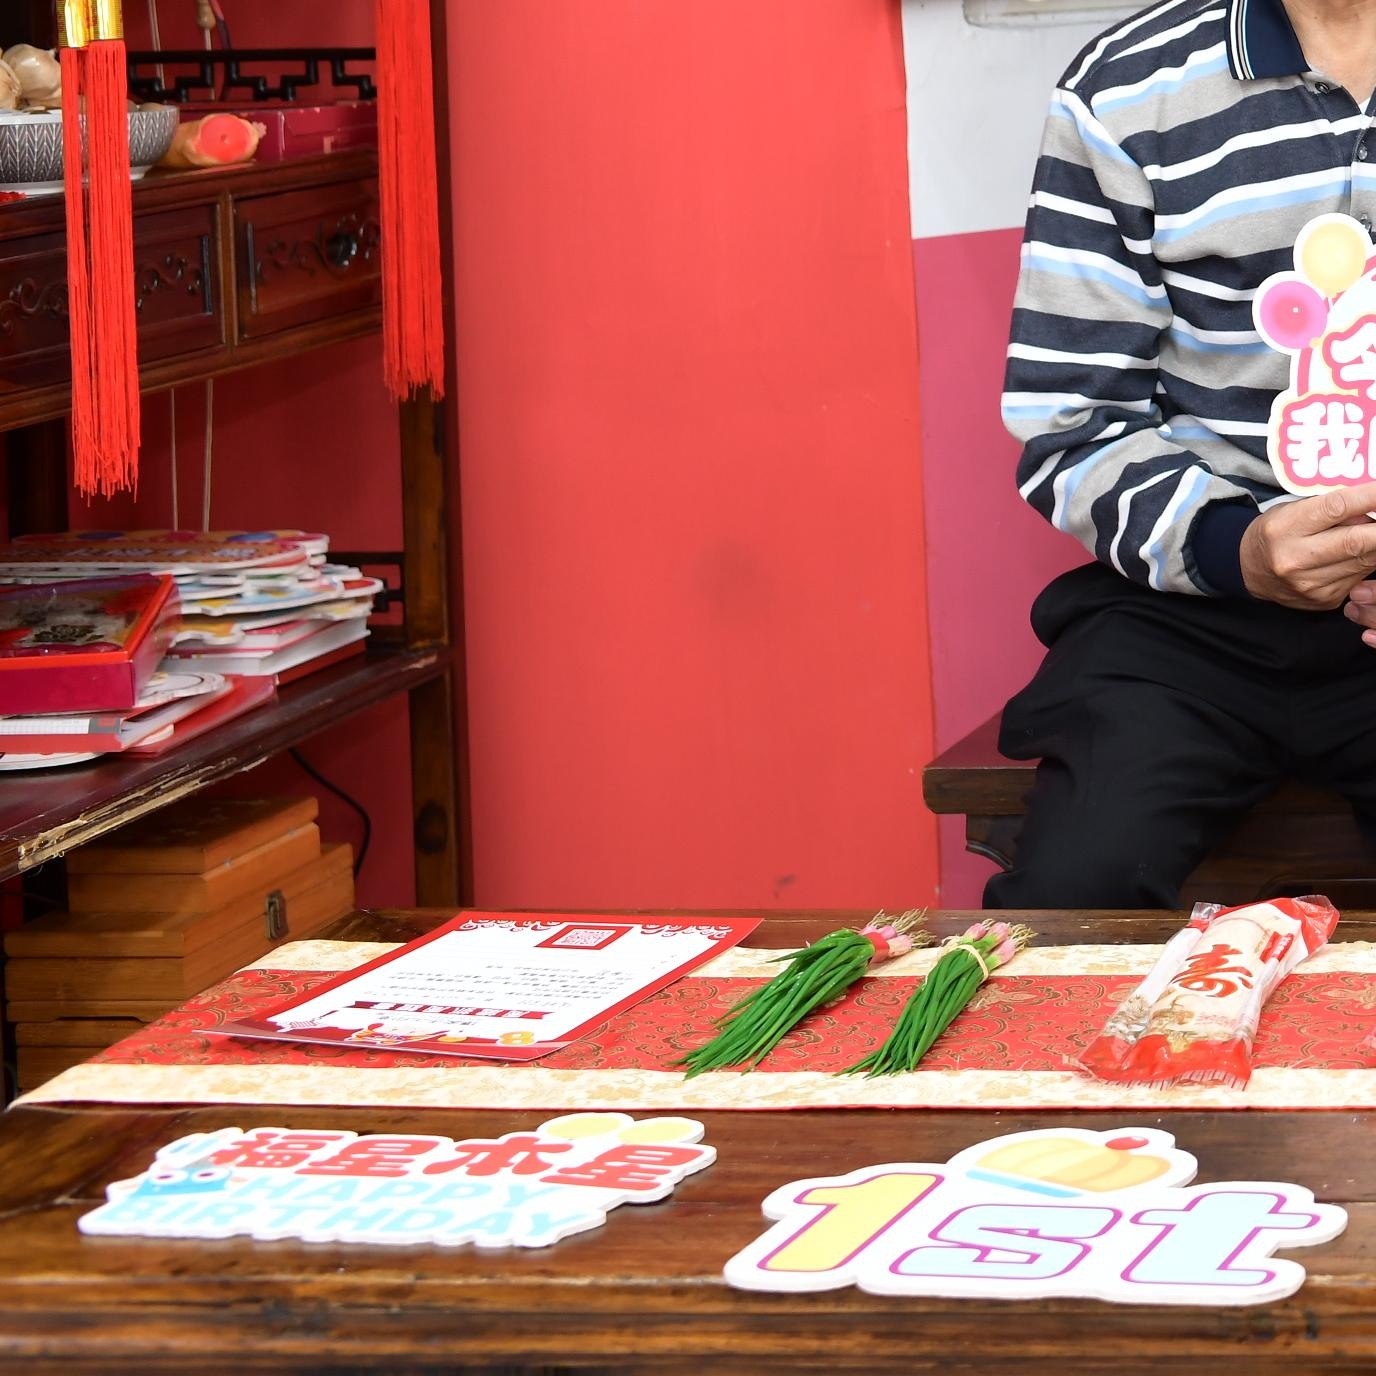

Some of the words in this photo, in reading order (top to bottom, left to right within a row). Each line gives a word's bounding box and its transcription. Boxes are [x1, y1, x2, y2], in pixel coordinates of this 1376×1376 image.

[233, 1174, 558, 1208] HAPPY
[99, 1197, 585, 1237] BIRTHDAY
[756, 1172, 1321, 1287] 1st
